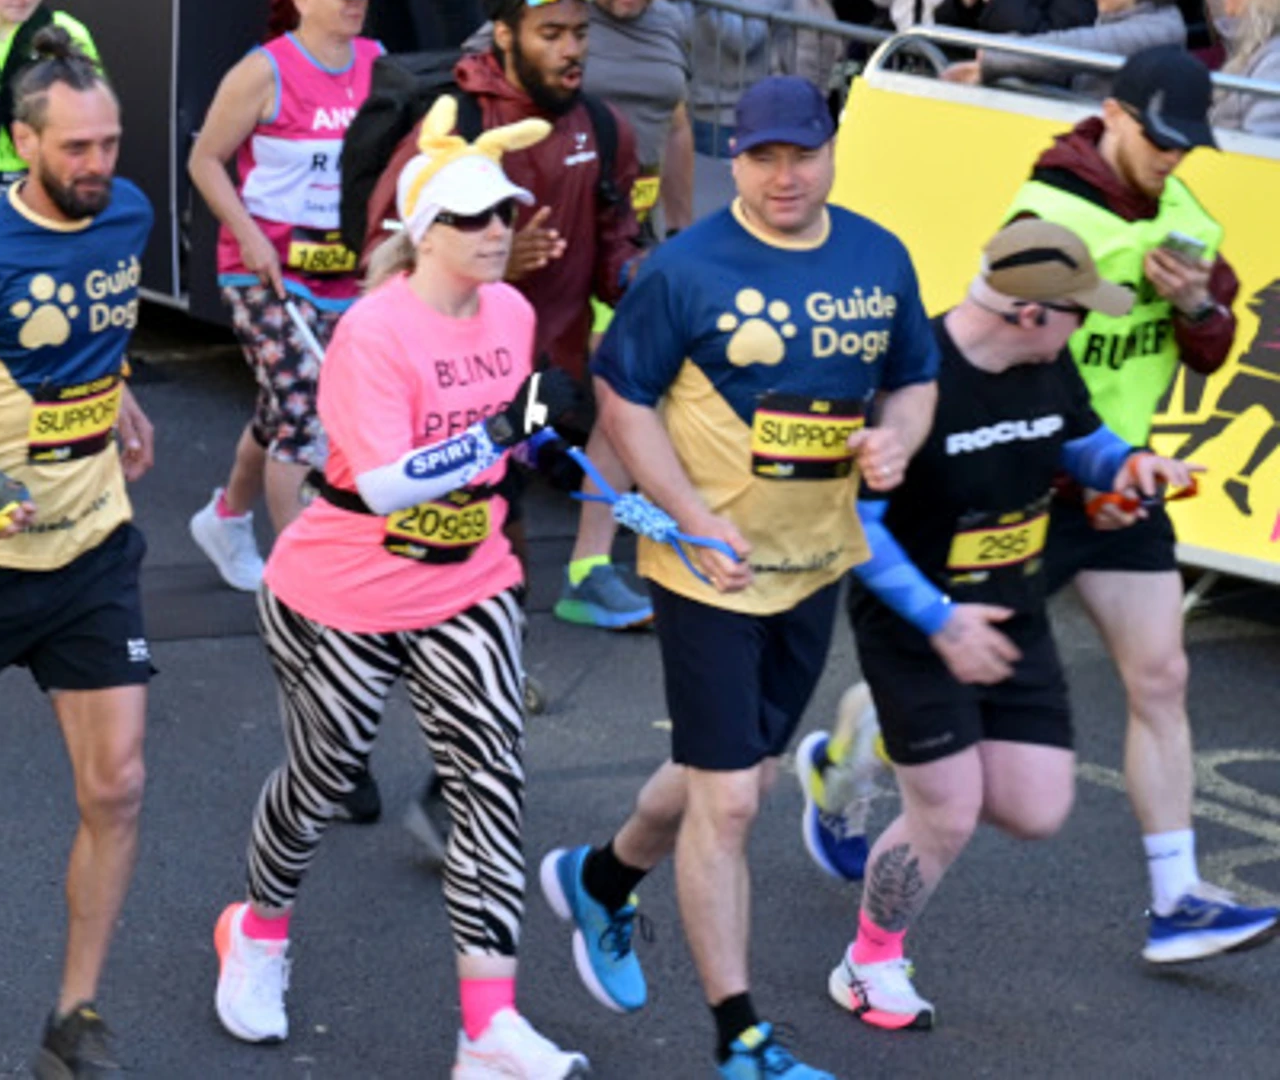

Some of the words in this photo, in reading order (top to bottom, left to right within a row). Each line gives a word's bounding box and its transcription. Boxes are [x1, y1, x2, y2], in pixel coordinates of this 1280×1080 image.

[85, 255, 141, 300] Guid
[89, 298, 139, 333] Dog
[806, 286, 897, 323] Guide
[811, 325, 890, 362] Dogs
[434, 346, 514, 389] BLIND
[35, 396, 120, 437] SUPPOR
[759, 420, 860, 446] SUPPOR
